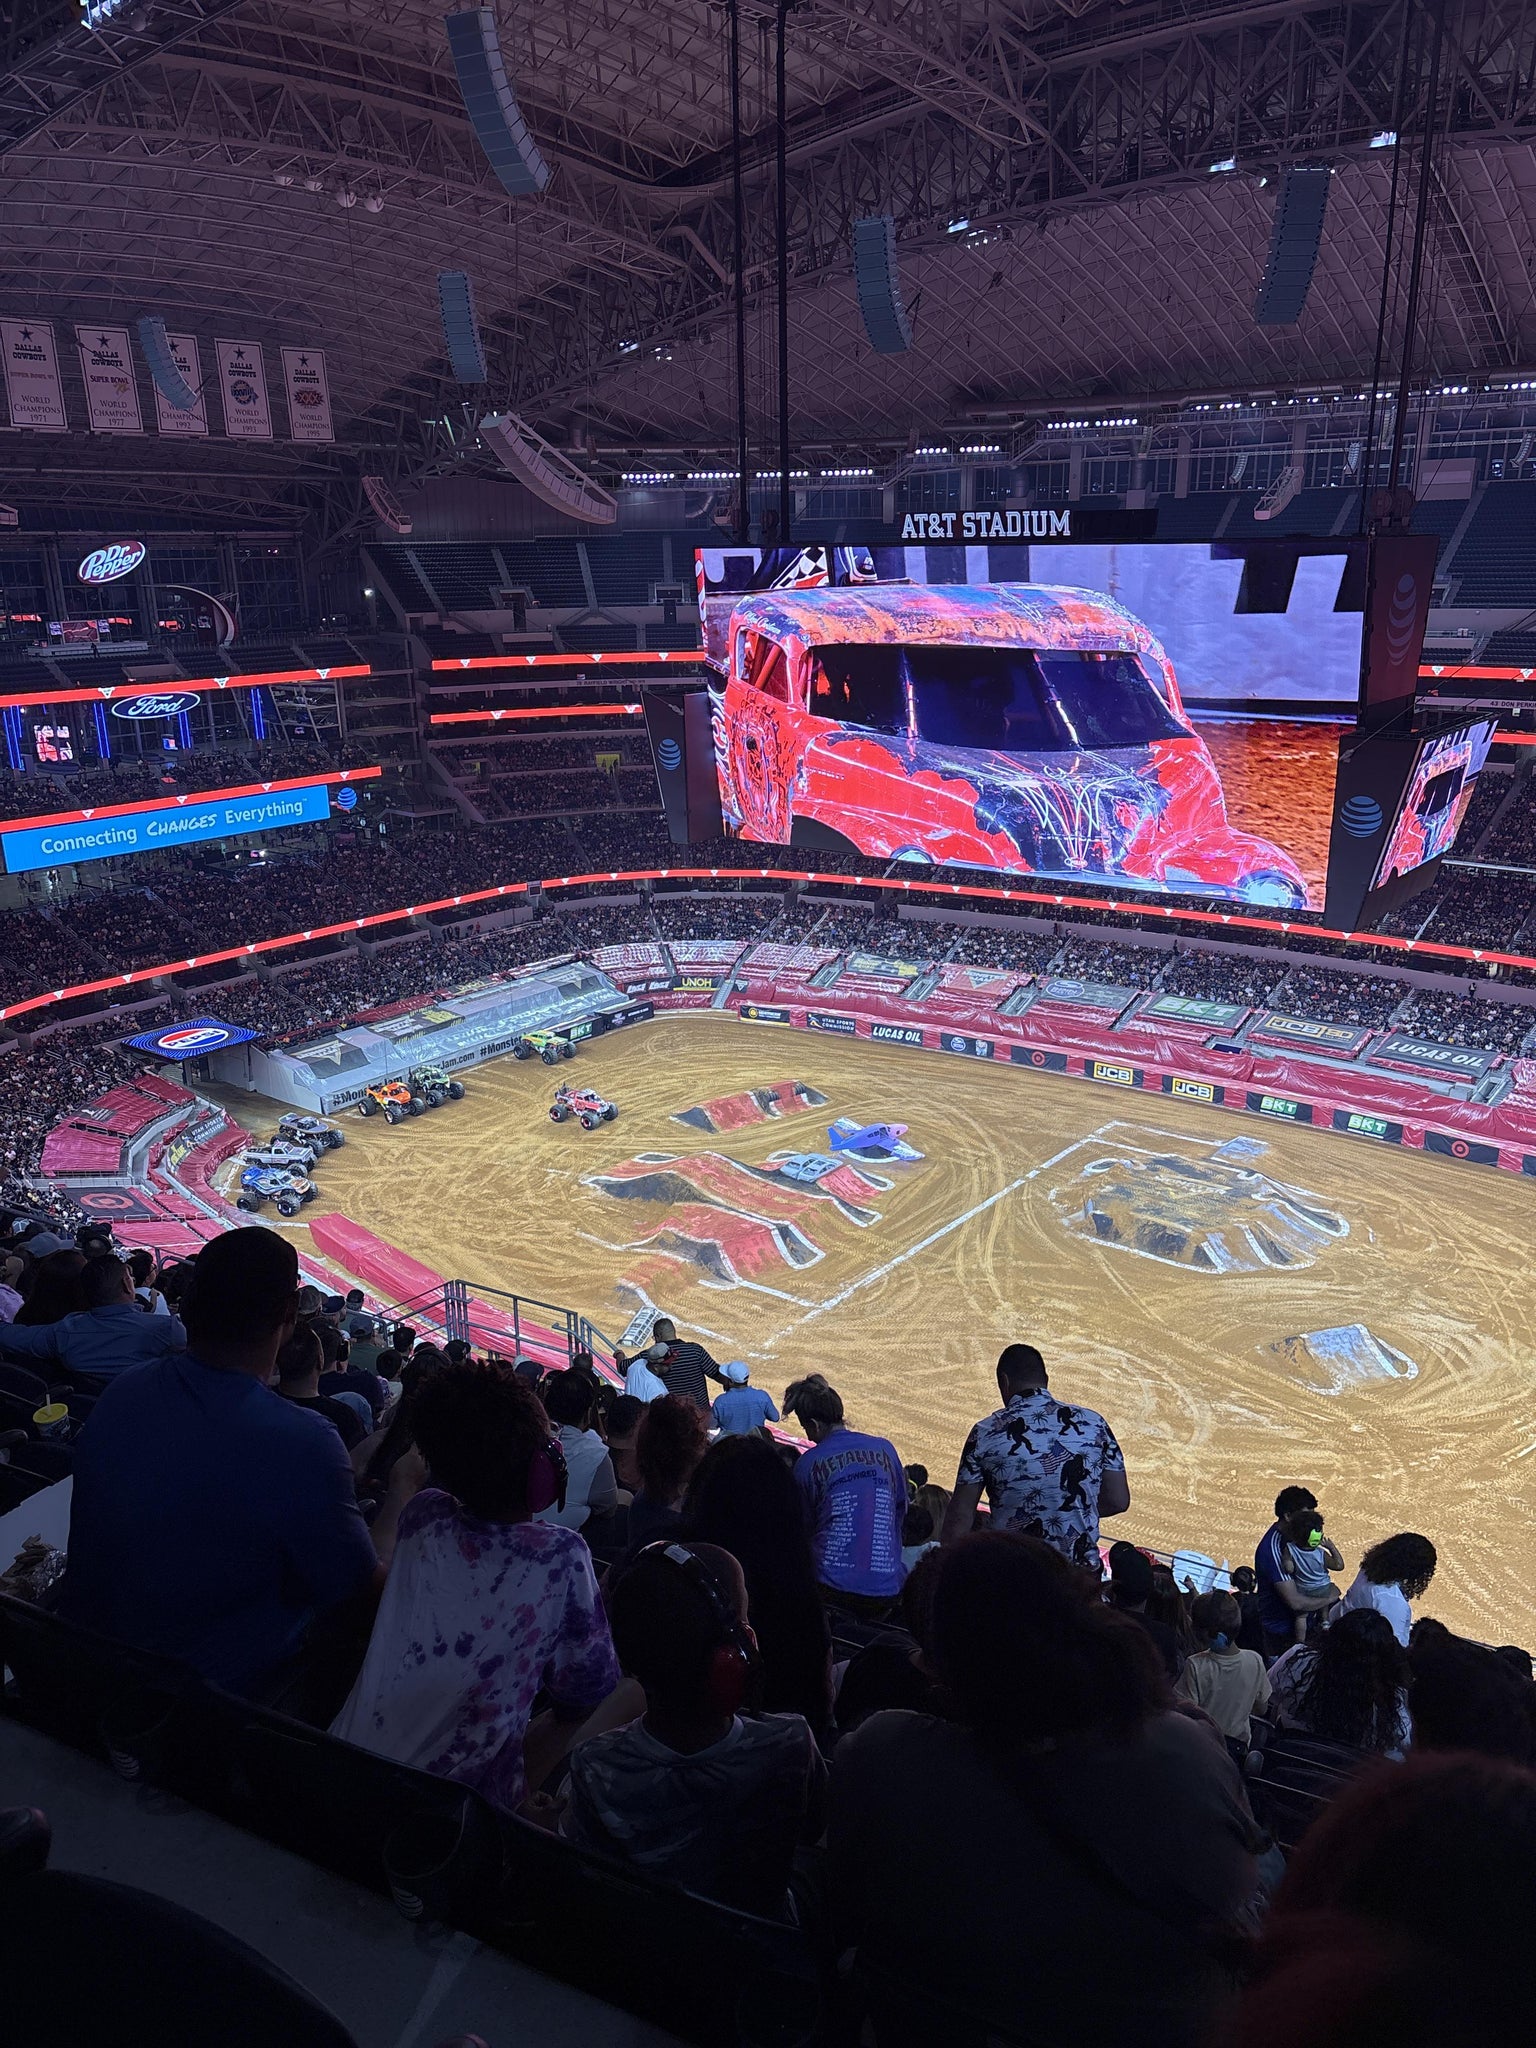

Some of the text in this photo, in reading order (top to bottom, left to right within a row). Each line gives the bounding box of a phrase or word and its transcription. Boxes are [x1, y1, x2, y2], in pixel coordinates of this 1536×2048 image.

[14, 344, 42, 353] DALLAS
[12, 352, 47, 361] COWBOYS
[92, 350, 119, 358] DALLAS
[92, 358, 124, 366] COWBOYS
[230, 362, 253, 370] DALLAS
[228, 370, 256, 378] COWBOYS
[90, 375, 130, 384] SUPER BOWL
[293, 376, 320, 384] COWBOYS
[21, 394, 50, 404] WORLD
[100, 400, 128, 408] WORLD
[14, 404, 60, 414] CHAMPIONS
[94, 409, 137, 418] CHAMPIONS
[235, 408, 260, 416] WORLD
[30, 414, 47, 422] 1971
[108, 418, 124, 426] 1977
[230, 416, 268, 425] CHAMPIONS
[176, 422, 191, 430] 1992
[294, 422, 330, 430] CHAMPIONS
[901, 510, 1071, 538] AT&T STADIUM
[105, 545, 130, 562] Dr
[83, 550, 141, 580] Pepper
[128, 695, 186, 715] Ford
[41, 800, 302, 854] Connecting CHANGES Everything
[682, 978, 712, 987] UNOH
[1154, 997, 1236, 1016] BKT
[570, 1022, 592, 1040] BKT
[1271, 1020, 1320, 1034] JCB
[166, 1030, 221, 1046] PEPSI
[872, 1026, 922, 1042] LUCAS OIL
[1386, 1042, 1482, 1068] LUCAS OIL
[1098, 1066, 1130, 1080] JCB
[1176, 1082, 1210, 1098] JCB
[1260, 1096, 1298, 1115] BKT
[1348, 1114, 1387, 1134] BKT
